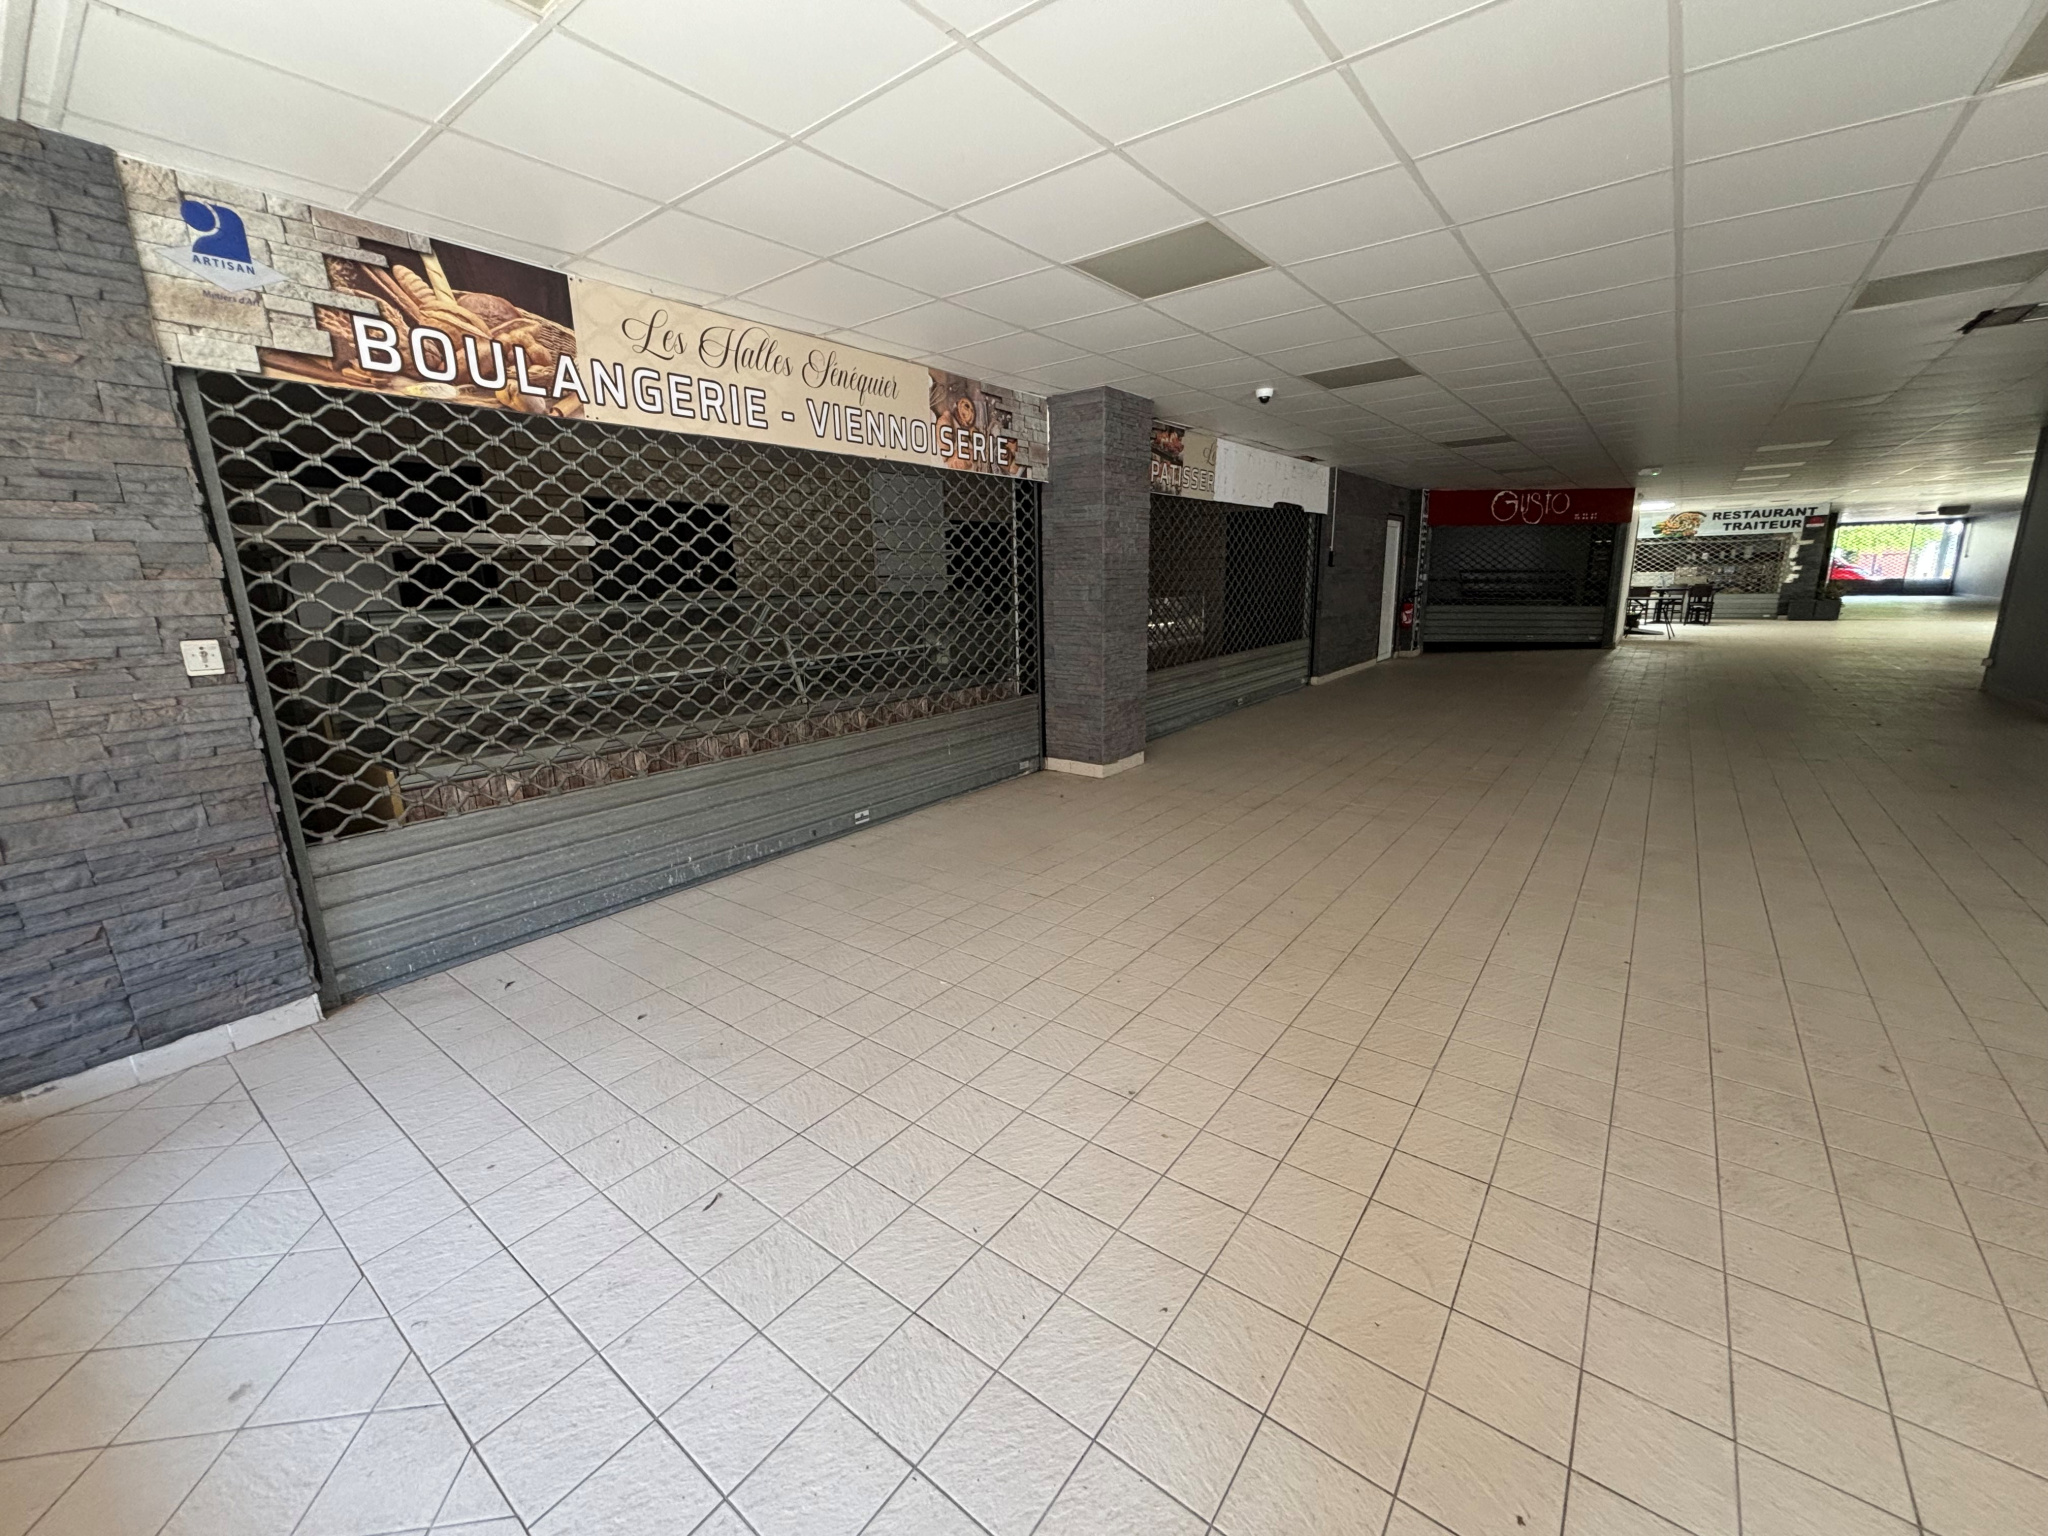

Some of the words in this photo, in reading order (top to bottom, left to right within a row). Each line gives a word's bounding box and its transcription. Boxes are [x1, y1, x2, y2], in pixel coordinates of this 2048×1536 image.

[193, 255, 255, 275] ARTISAN
[621, 309, 687, 360] Les
[700, 326, 793, 377] Halles
[802, 350, 899, 405] Sénéquier
[353, 314, 768, 429] BOULANGERIE
[781, 410, 796, 422] -
[806, 398, 1009, 466] VIENNOISERIE
[1712, 507, 1818, 520] RESTAURANT
[1722, 519, 1802, 531] TRAITEUR
